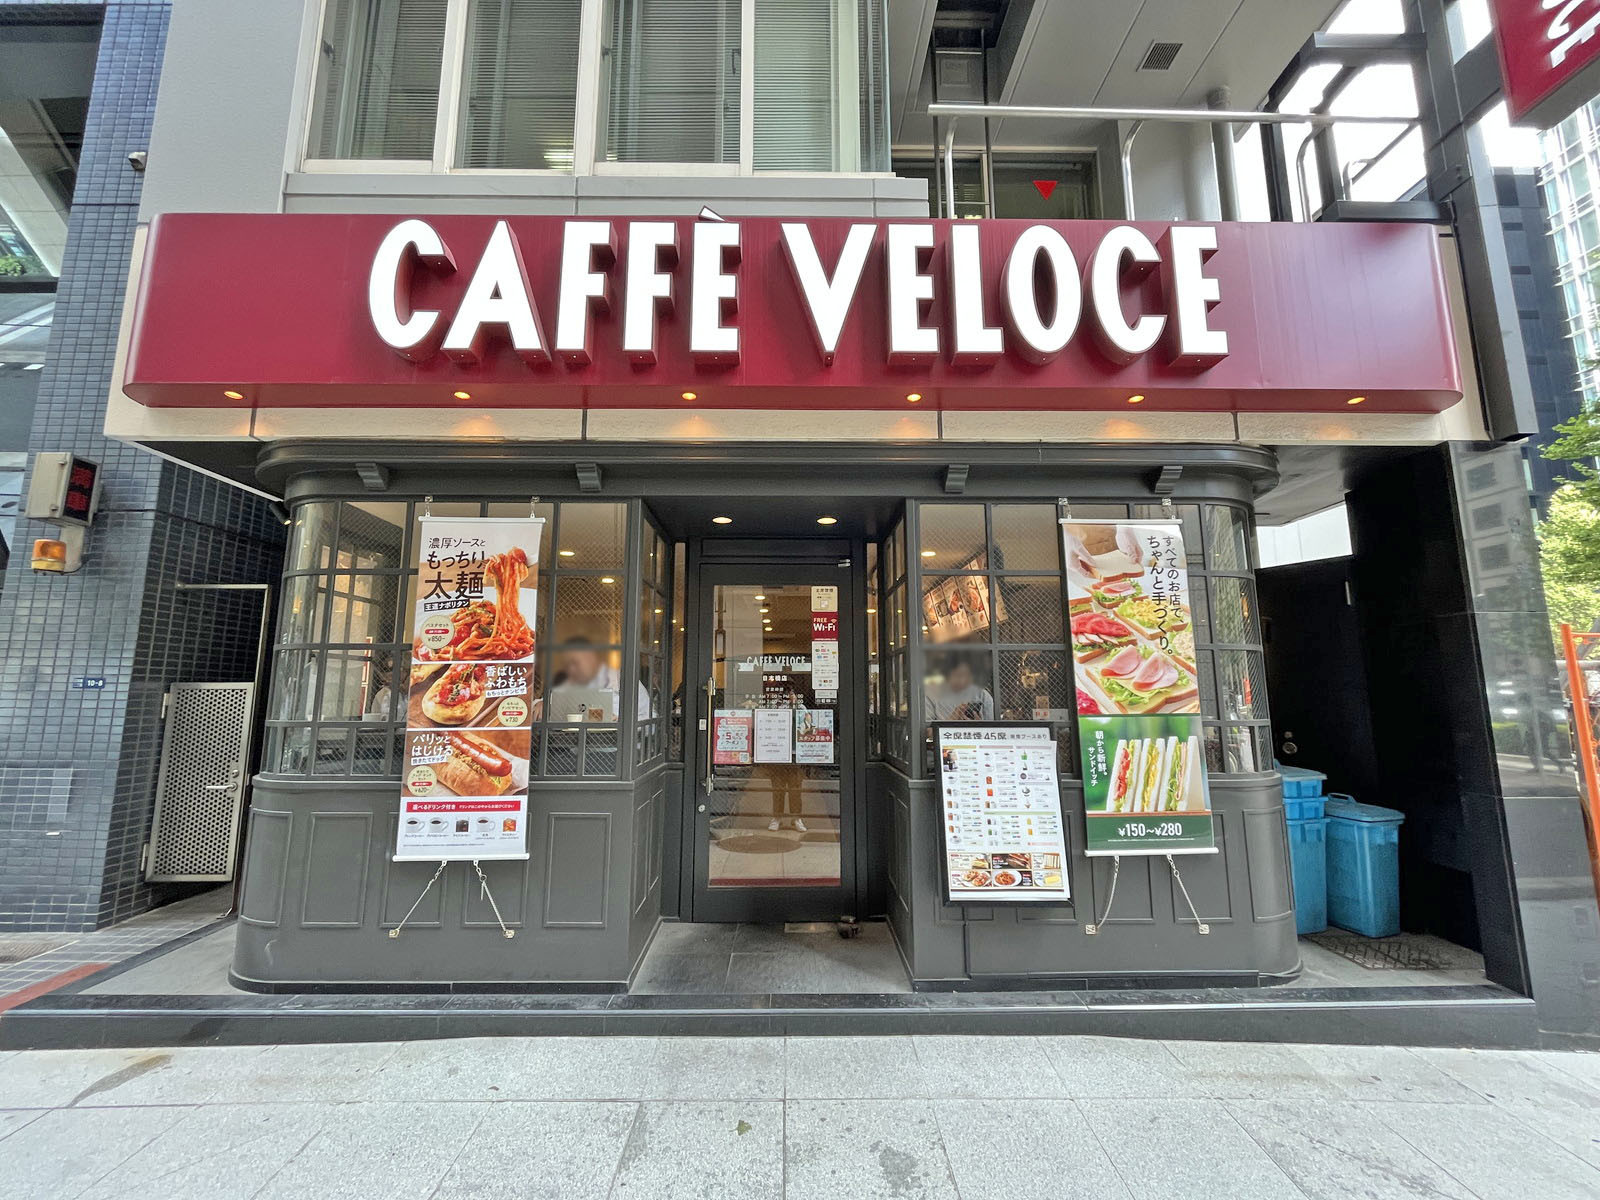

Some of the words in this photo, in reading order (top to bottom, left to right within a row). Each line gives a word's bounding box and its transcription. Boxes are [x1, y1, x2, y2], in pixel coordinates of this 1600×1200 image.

[780, 223, 1230, 354] VELOCE
[428, 537, 487, 549] 濃厚ソースと
[426, 550, 487, 570] もっちり
[423, 571, 485, 600] 太麺
[1162, 535, 1184, 623] すべてのお店で、
[1147, 535, 1173, 655] ちゃんと手づくり。
[424, 600, 470, 612] 王道ナポリタン
[813, 623, 836, 632] Wi-Fi
[485, 665, 528, 677] 香ばしい
[485, 677, 528, 689] ふわもち
[412, 733, 451, 745] パリッと
[411, 744, 453, 756] はじける
[1095, 730, 1108, 776] 朝から新鮮。
[1088, 747, 1098, 787] サンドイッチ
